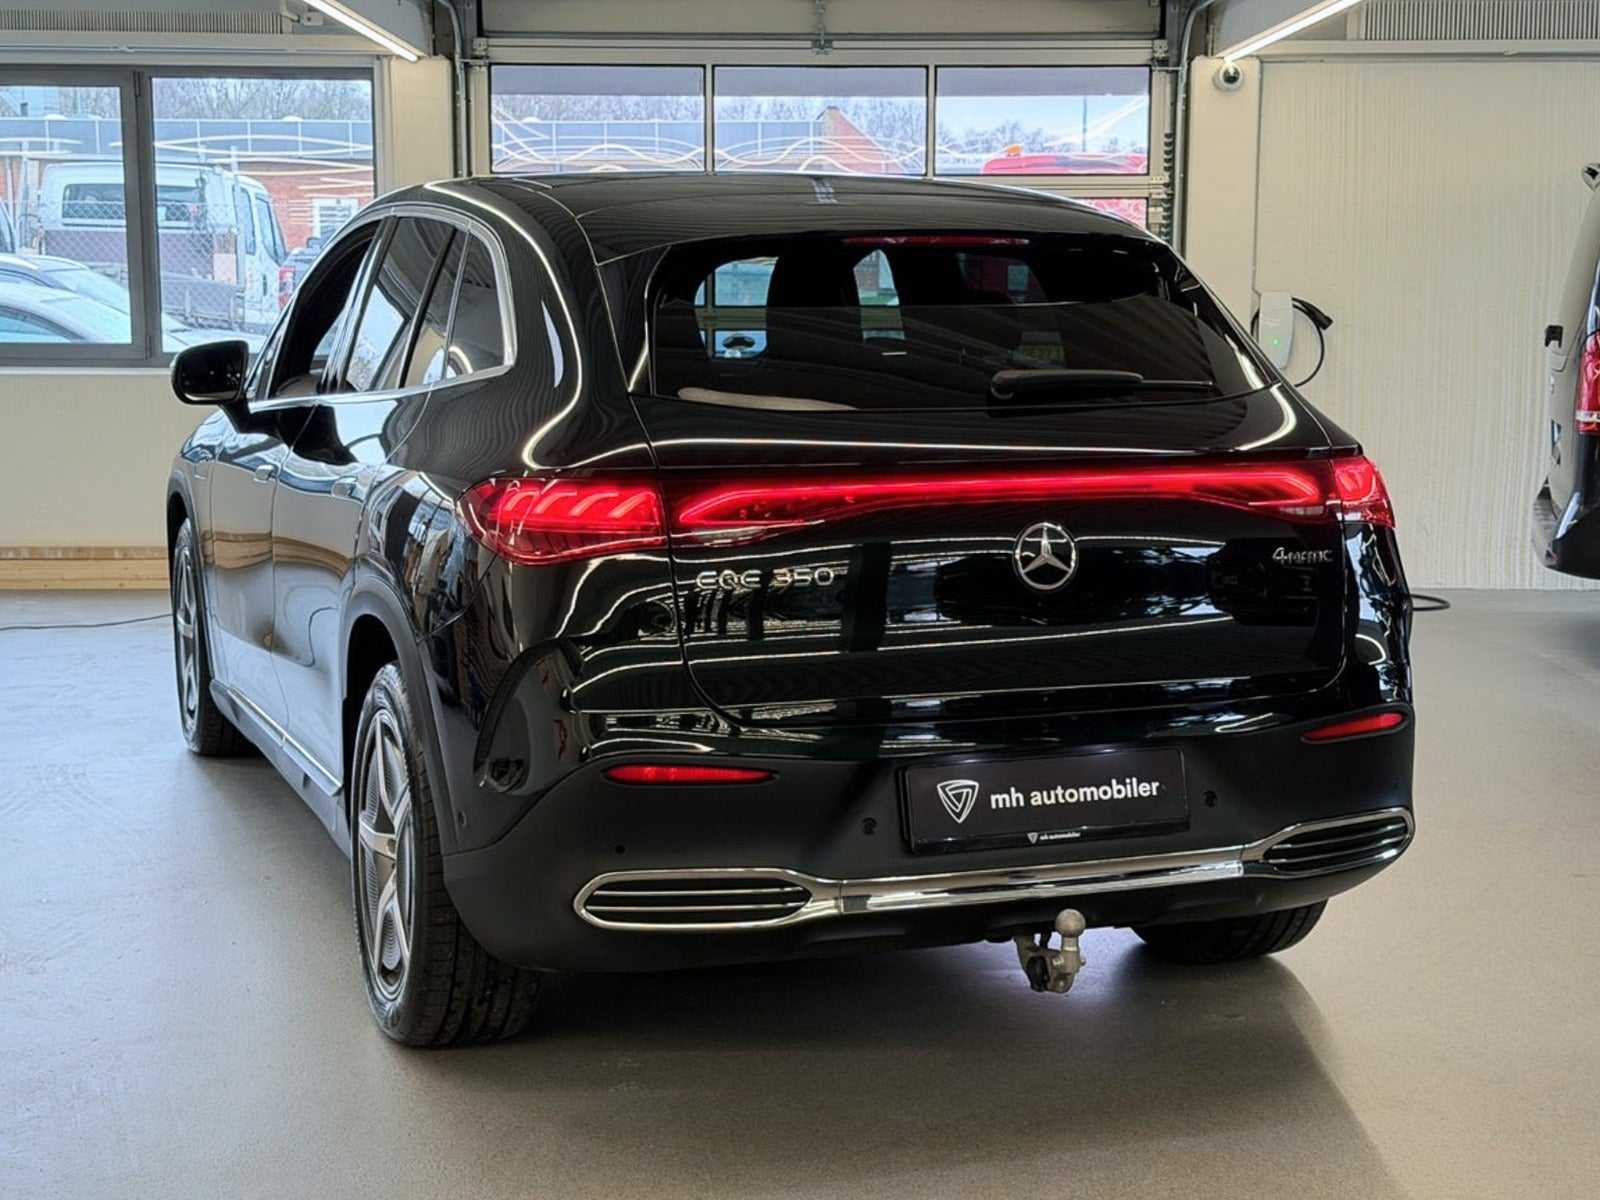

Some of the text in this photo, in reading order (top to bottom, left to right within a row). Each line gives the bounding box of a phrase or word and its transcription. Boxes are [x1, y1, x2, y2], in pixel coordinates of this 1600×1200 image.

[1272, 547, 1333, 564] 4MATIC
[696, 567, 835, 590] EQE 350
[990, 777, 1160, 809] mh automobiler
